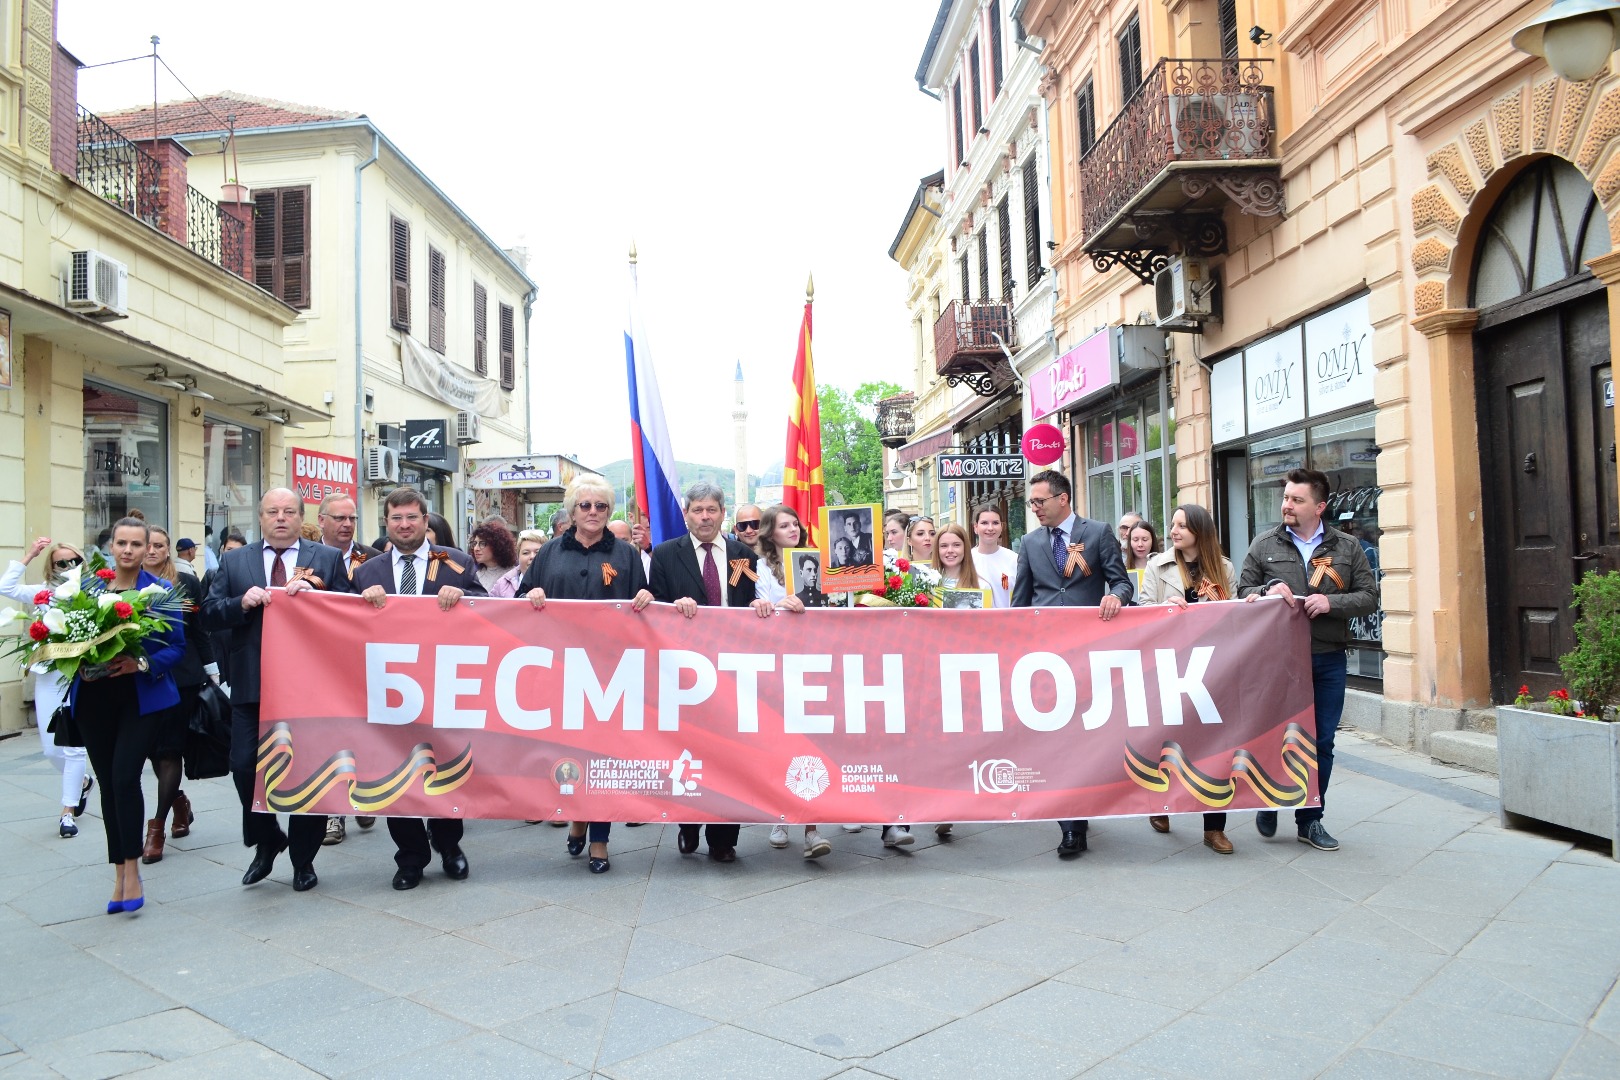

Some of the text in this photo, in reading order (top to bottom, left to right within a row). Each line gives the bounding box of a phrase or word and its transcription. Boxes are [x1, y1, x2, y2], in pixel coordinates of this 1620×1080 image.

[1317, 333, 1366, 382] ONIX
[1048, 362, 1087, 408] Penti
[1255, 362, 1294, 405] ONIX
[1029, 438, 1061, 451] Penti
[296, 453, 354, 484] BURNIK
[941, 458, 1023, 477] MORITZ
[143, 467, 151, 486] 2
[365, 642, 1223, 735] БЕСМРТЕН ПОЛК
[590, 757, 670, 771] МЕЃУНАРОДЕН
[841, 764, 884, 774] СОЈУЗ НА
[589, 769, 659, 780] СЛАВЈАНСКИ
[841, 774, 899, 784] БОРЦИТЕ НА
[589, 779, 665, 790] УНИВЕРЗИТЕТ
[842, 784, 876, 793] НОАВМ
[1017, 784, 1031, 792] ЛЕТ
